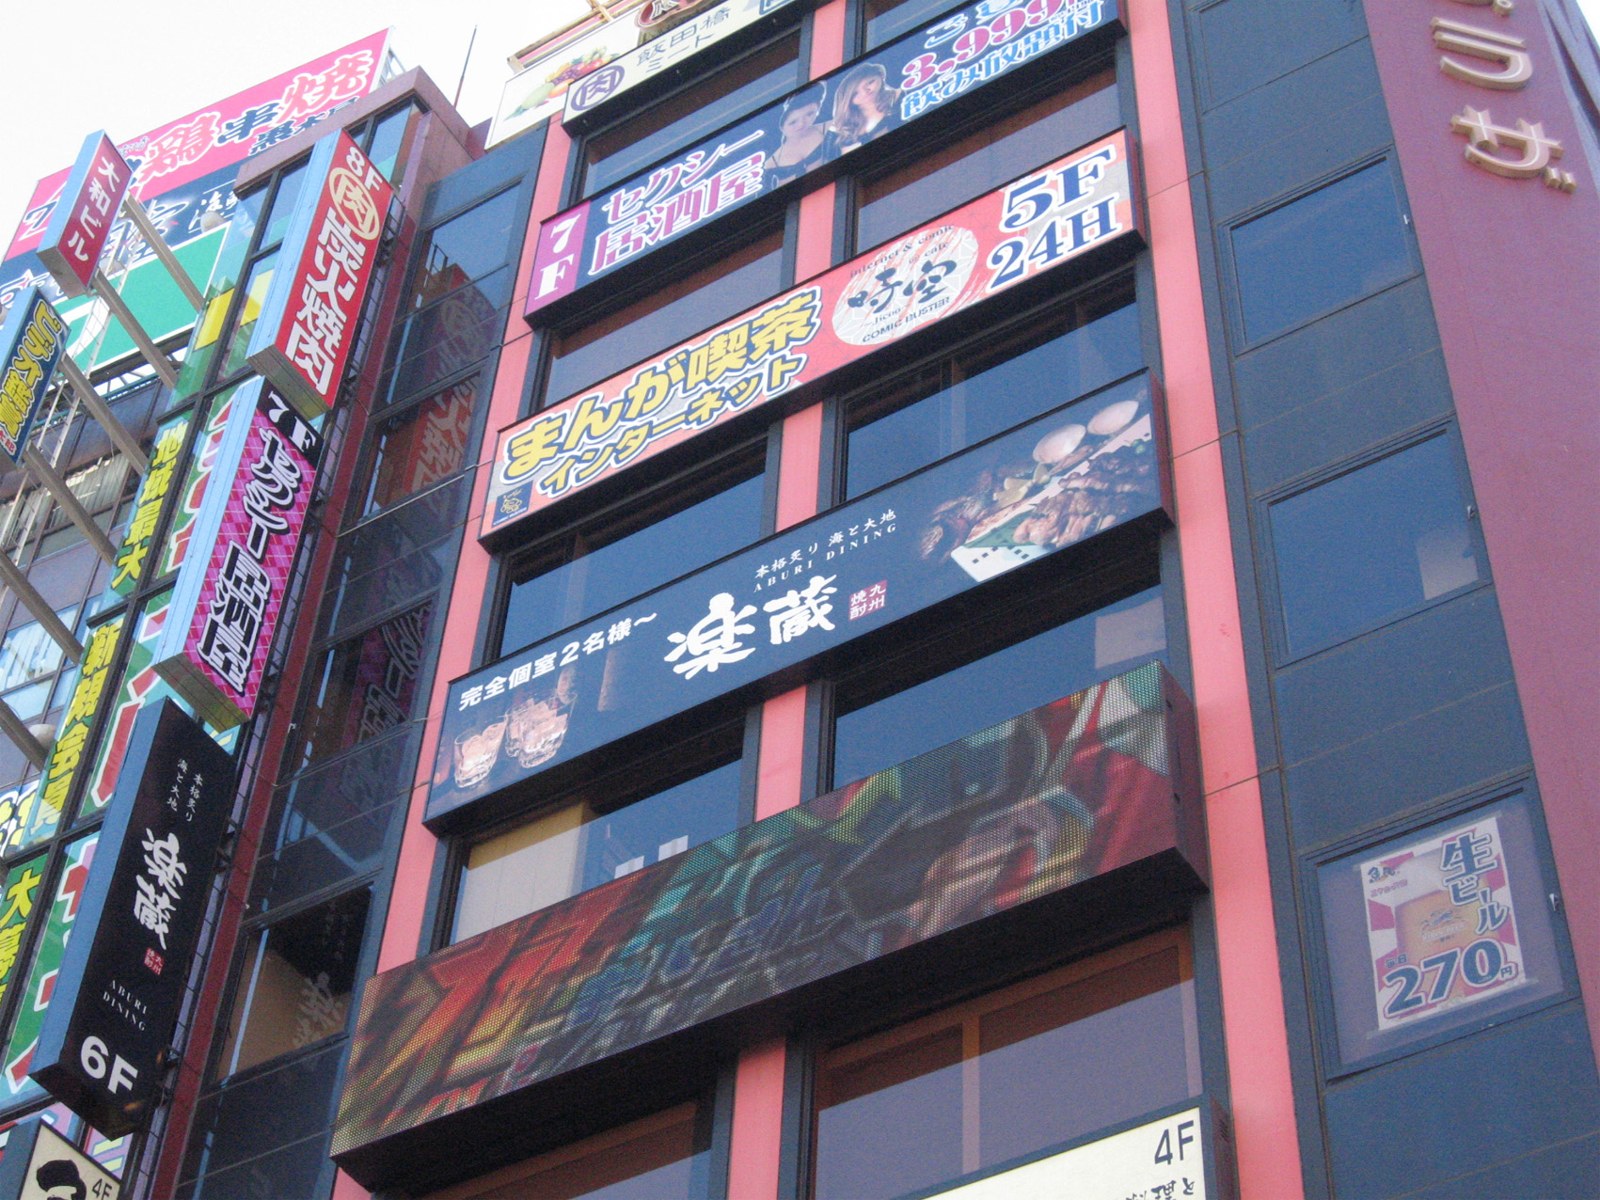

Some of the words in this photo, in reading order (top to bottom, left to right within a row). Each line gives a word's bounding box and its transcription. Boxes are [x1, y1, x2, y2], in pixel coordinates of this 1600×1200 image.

[636, 6, 731, 66] 飯田橋
[646, 33, 714, 73] ミート
[901, 2, 1103, 121] 飲み放題付
[575, 67, 622, 110] 肉
[1430, 0, 1578, 195] ラザ
[331, 169, 379, 238] 肉
[346, 146, 383, 191] 8F
[602, 130, 765, 225] セクシー
[1002, 146, 1115, 231] 5F
[68, 156, 120, 261] 大和ビル
[588, 151, 766, 276] 居酒屋
[988, 194, 1120, 292] 24H
[850, 250, 901, 278] internet
[918, 224, 955, 245] comic
[285, 207, 366, 395] 炭火焼肉
[862, 318, 902, 343] COMIC
[905, 296, 950, 324] BUSTER
[503, 288, 819, 482] まんが喫茶
[268, 391, 317, 453] 7F
[540, 357, 804, 496] インターネット
[111, 421, 188, 589] 地域最大
[753, 560, 814, 593] ABURI
[825, 523, 897, 561] DINING
[755, 542, 819, 580] 本格炙り
[828, 508, 897, 549] 海と大地
[664, 574, 838, 680] 楽蔵
[849, 590, 868, 620] 焼酎
[867, 583, 887, 613] 九州
[136, 828, 188, 950] 楽蔵
[1441, 832, 1510, 935] 生ビール
[102, 991, 146, 1032] DINING
[110, 979, 148, 1015] ABURI
[80, 1035, 139, 1095] 6F
[1154, 1120, 1195, 1165] 4F
[92, 1178, 113, 1200] 4F
